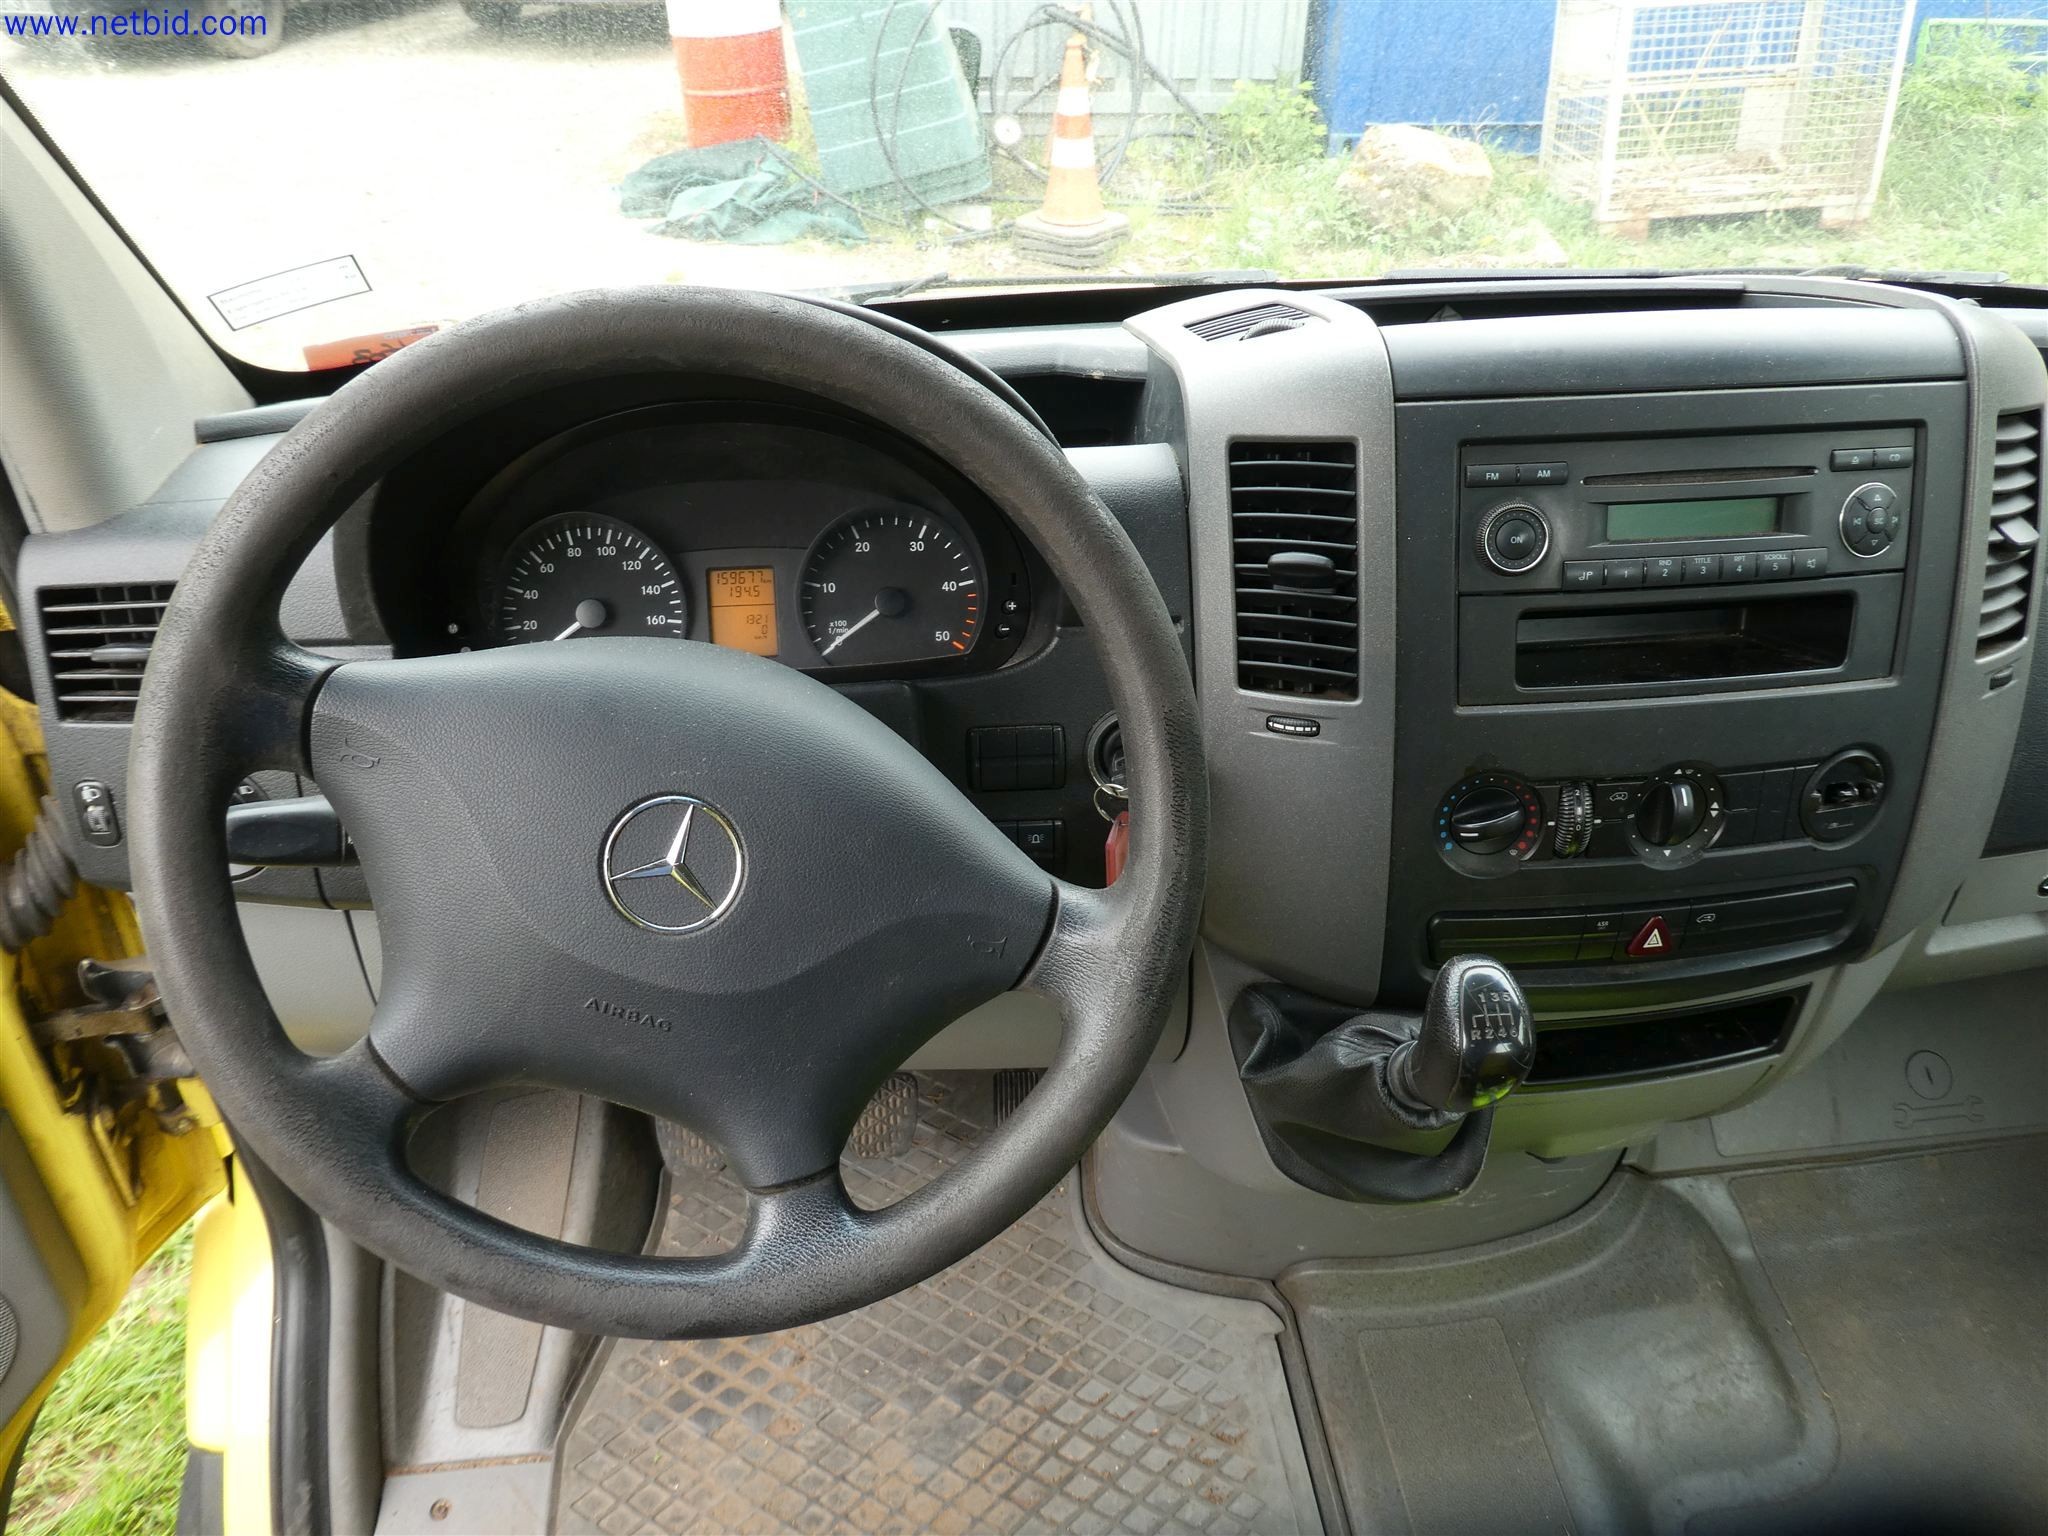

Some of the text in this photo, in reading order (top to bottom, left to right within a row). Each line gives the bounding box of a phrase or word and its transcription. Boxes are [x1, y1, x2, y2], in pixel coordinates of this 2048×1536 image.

[1486, 472, 1499, 480] FM
[1537, 469, 1551, 478] AM
[1510, 536, 1523, 544] ON
[596, 546, 617, 556] 100
[855, 541, 871, 553] 20
[909, 541, 925, 552] 30
[567, 547, 582, 557] 80
[540, 563, 555, 573] 60
[622, 561, 642, 571] 120
[1700, 566, 1707, 575] 3
[1736, 565, 1743, 573] 4
[1772, 563, 1779, 571] 5
[717, 571, 764, 585] 159677
[1662, 569, 1668, 577] 2
[641, 585, 661, 595] 140
[822, 582, 836, 593] 10
[941, 581, 957, 592] 40
[523, 590, 539, 600] 40
[646, 615, 666, 625] 160
[829, 620, 848, 628] x100
[523, 620, 538, 631] 20
[935, 630, 950, 641] 50
[1490, 992, 1500, 1002] 3
[1502, 992, 1511, 1002] 5
[584, 998, 672, 1033] AIRBAG
[1471, 1029, 1481, 1041] R
[1485, 1028, 1494, 1039] 2
